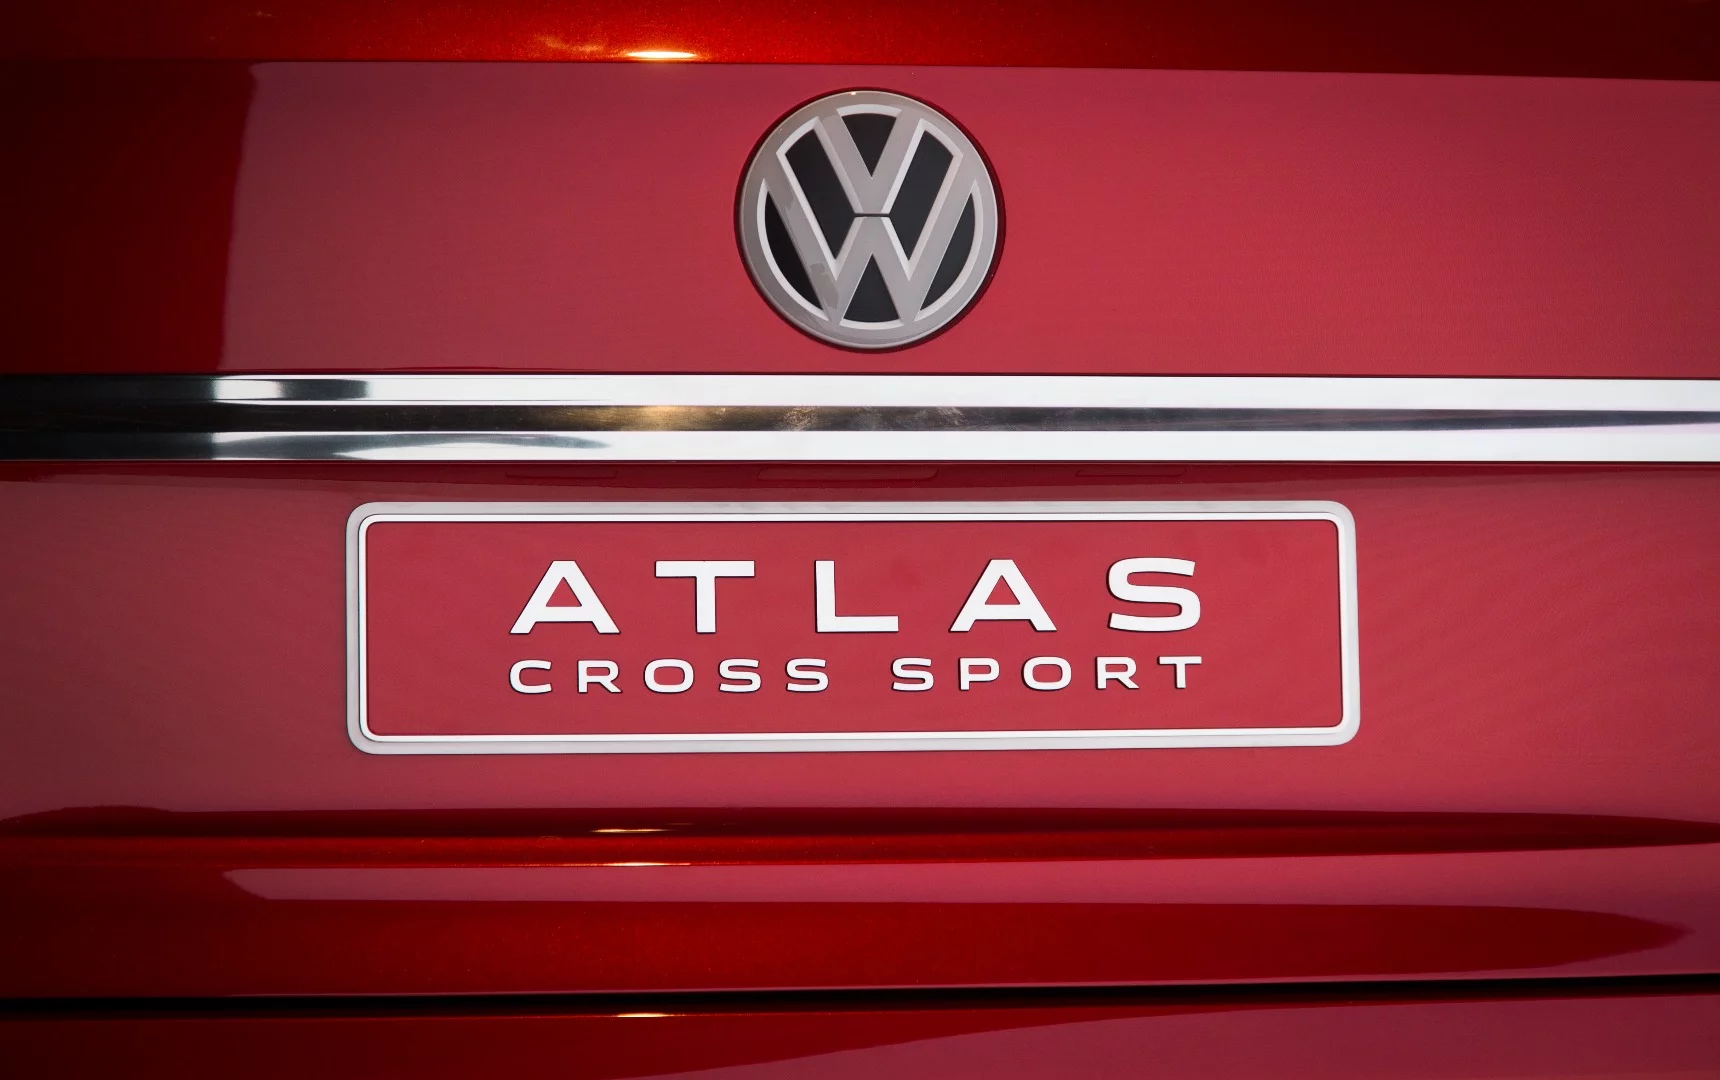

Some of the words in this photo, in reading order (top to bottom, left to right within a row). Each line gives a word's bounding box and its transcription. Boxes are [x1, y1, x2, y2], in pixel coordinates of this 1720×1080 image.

[510, 557, 1202, 635] ATLAS
[509, 658, 829, 695] CROSS
[891, 655, 1203, 692] SPORT
